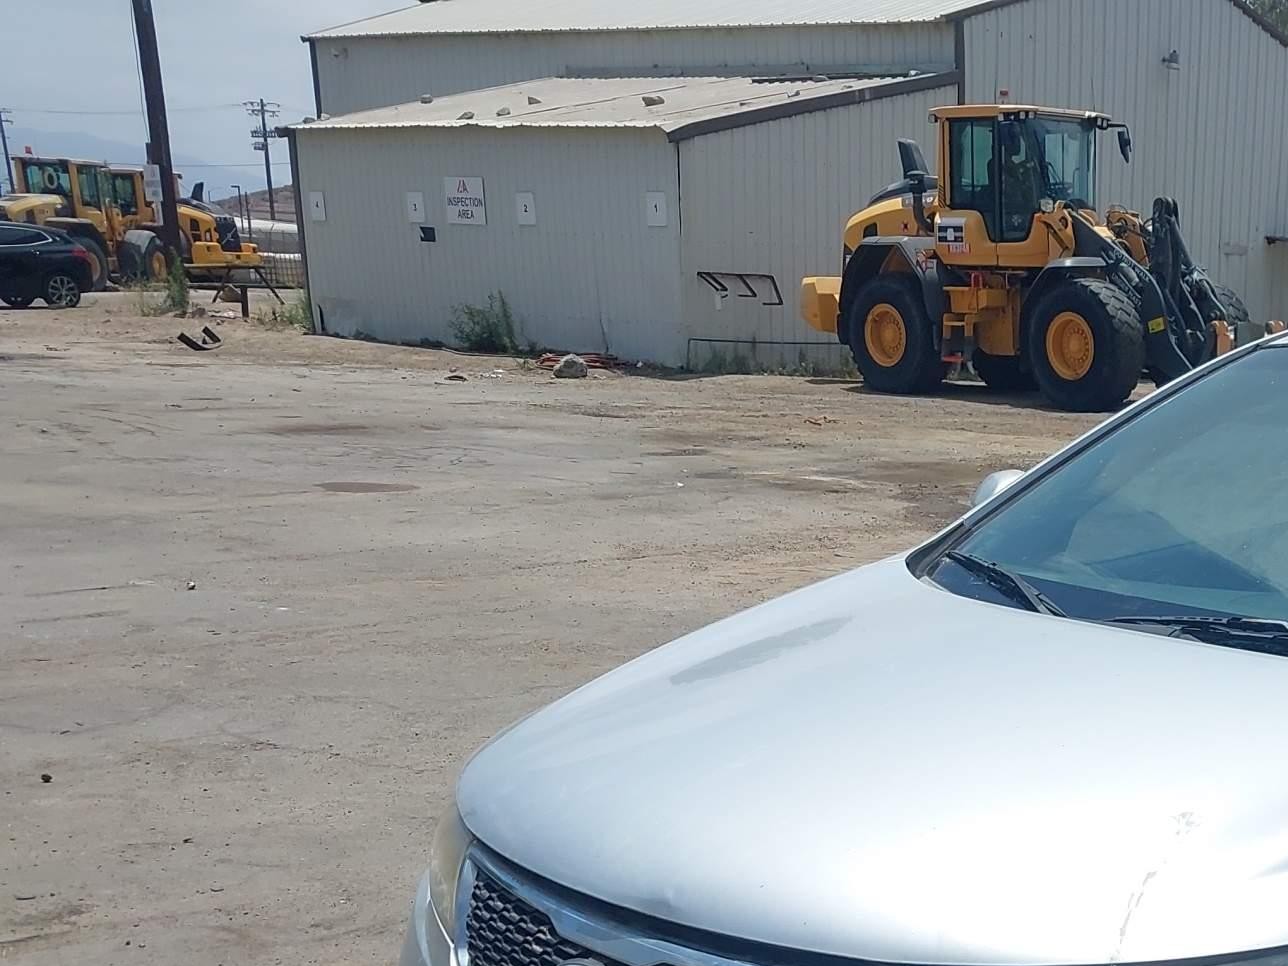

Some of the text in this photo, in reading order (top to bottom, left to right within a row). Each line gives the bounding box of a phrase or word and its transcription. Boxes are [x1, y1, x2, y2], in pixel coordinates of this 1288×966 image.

[447, 196, 483, 207] INSPECTION
[457, 208, 475, 220] AREA
[523, 204, 528, 213] 2
